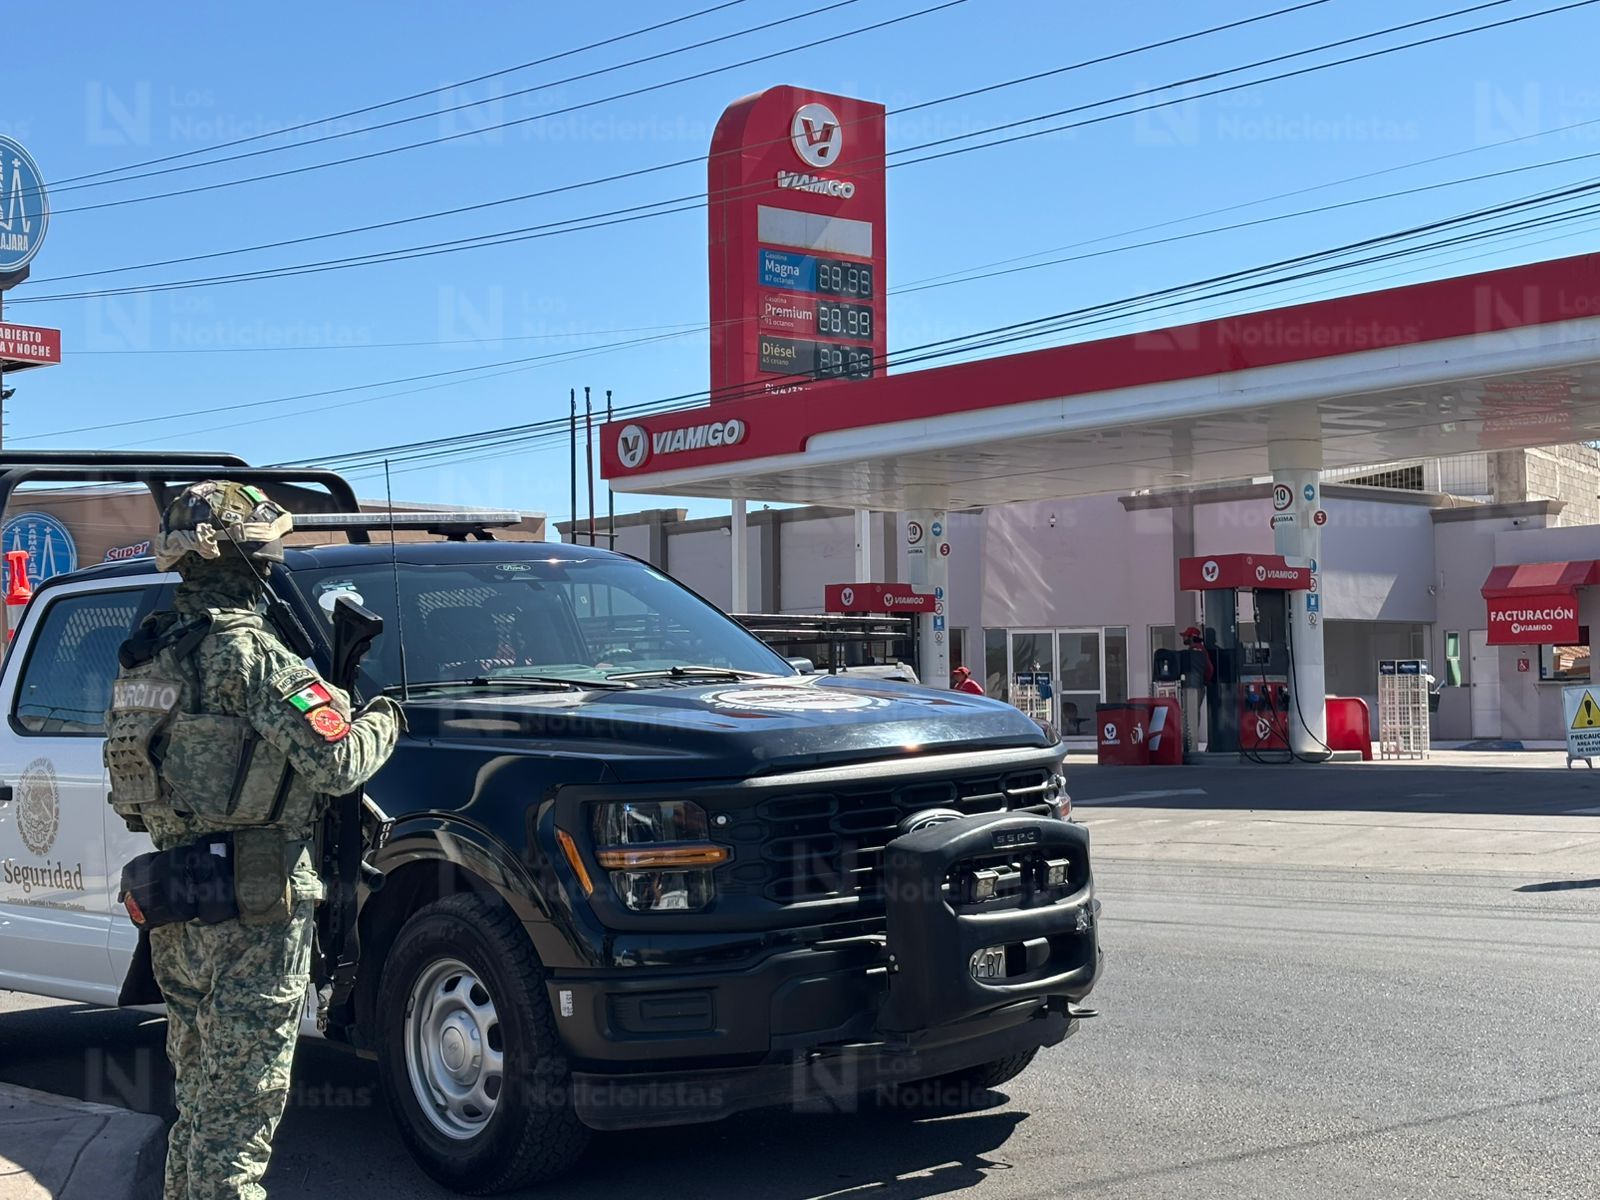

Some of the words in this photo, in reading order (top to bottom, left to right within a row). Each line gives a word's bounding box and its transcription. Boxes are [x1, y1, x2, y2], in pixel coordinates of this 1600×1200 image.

[777, 170, 855, 199] VIAMIGO
[765, 259, 800, 277] Magna
[764, 303, 813, 320] Premium
[0, 328, 42, 343] ABIERTO
[16, 343, 51, 357] NOCHE
[762, 342, 797, 358] Diésel
[652, 419, 745, 455] VIAMIGO
[1275, 489, 1286, 501] 10
[106, 541, 150, 561] Super
[1267, 569, 1299, 579] VIAMIGO
[894, 596, 925, 605] VIAMIGO
[1490, 606, 1574, 622] FACTURACIÓN
[996, 831, 1035, 843] SSPC
[4, 859, 85, 893] Seguridad
